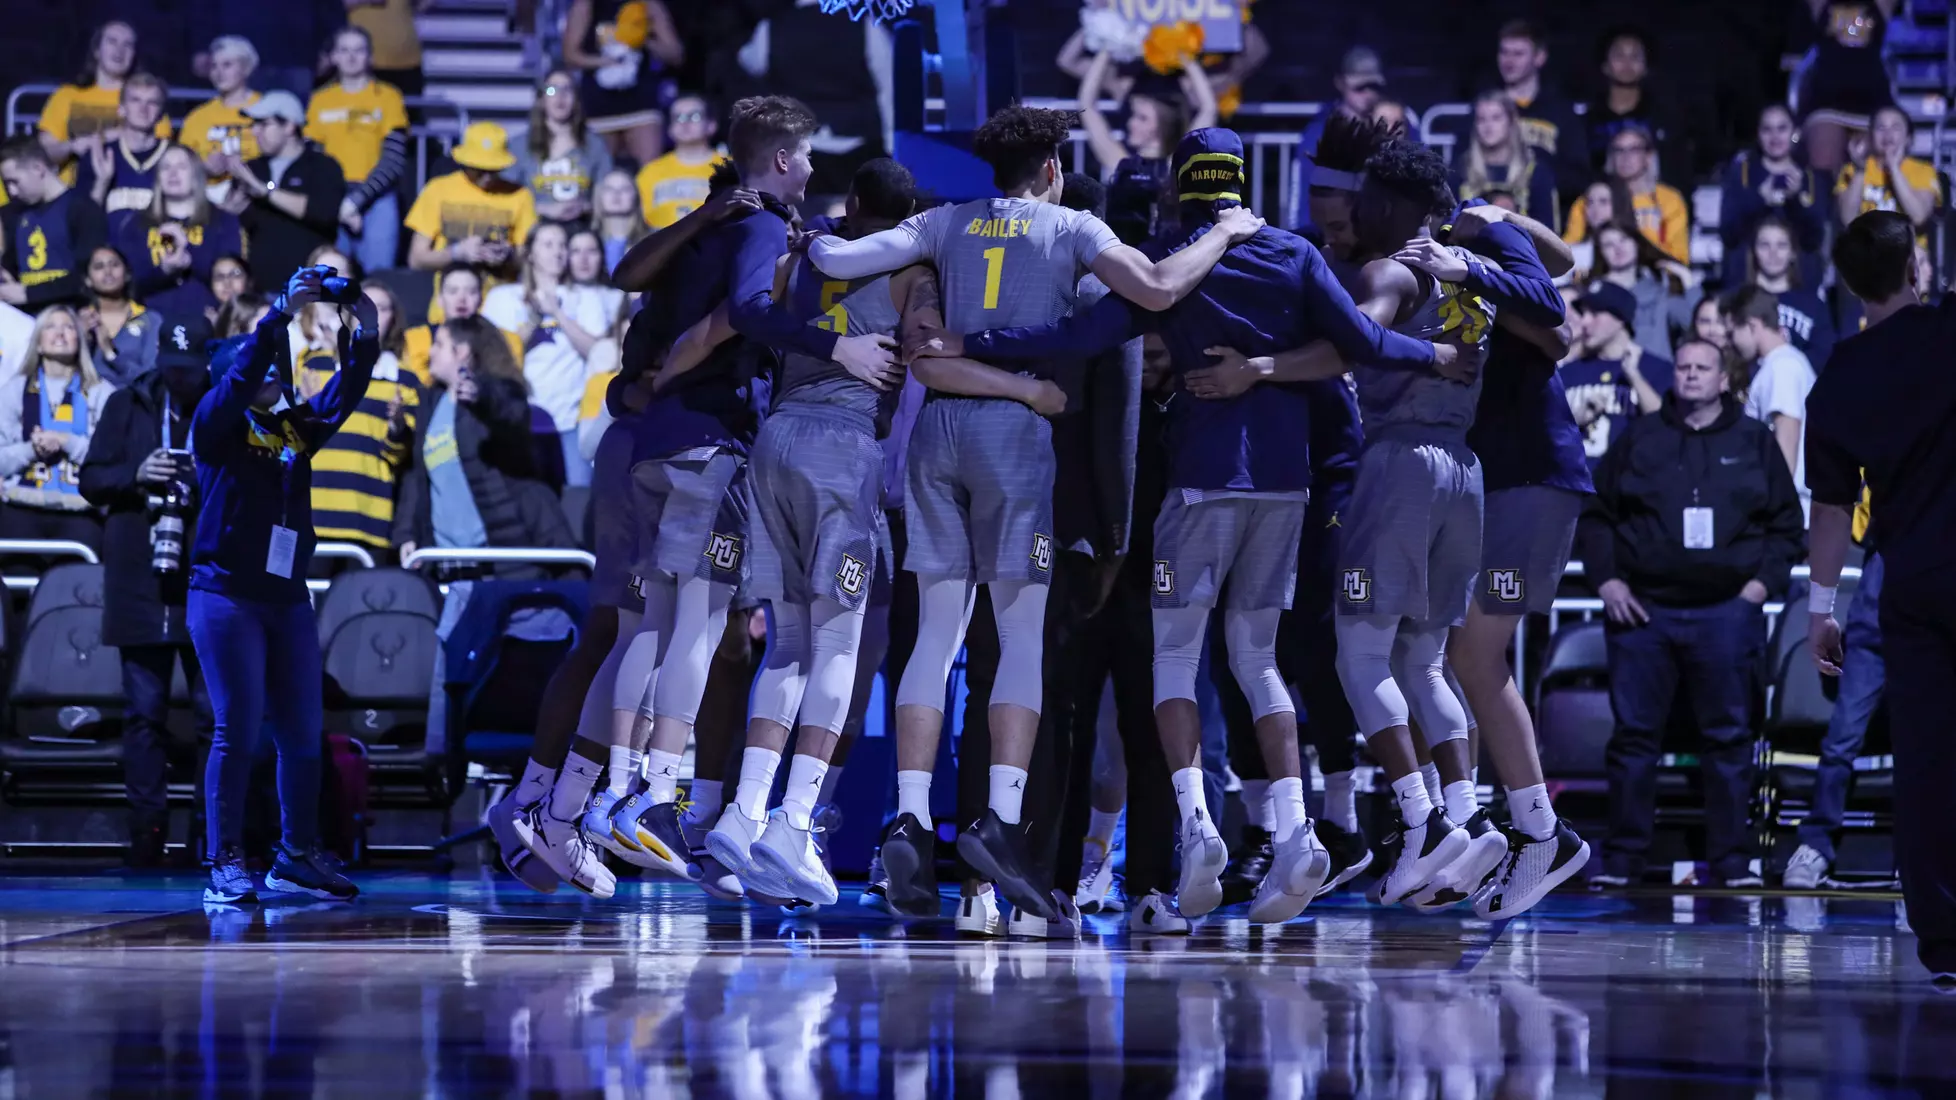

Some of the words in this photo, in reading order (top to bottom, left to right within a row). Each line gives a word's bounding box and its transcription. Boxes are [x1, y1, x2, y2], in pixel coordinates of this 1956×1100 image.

[968, 218, 1033, 238] BAILEY
[27, 231, 47, 270] 3
[983, 247, 1005, 310] 1
[705, 532, 740, 571] MU
[1031, 533, 1051, 571] MU
[837, 554, 865, 595] MU
[1343, 569, 1371, 602] MU
[1488, 569, 1524, 602] MU
